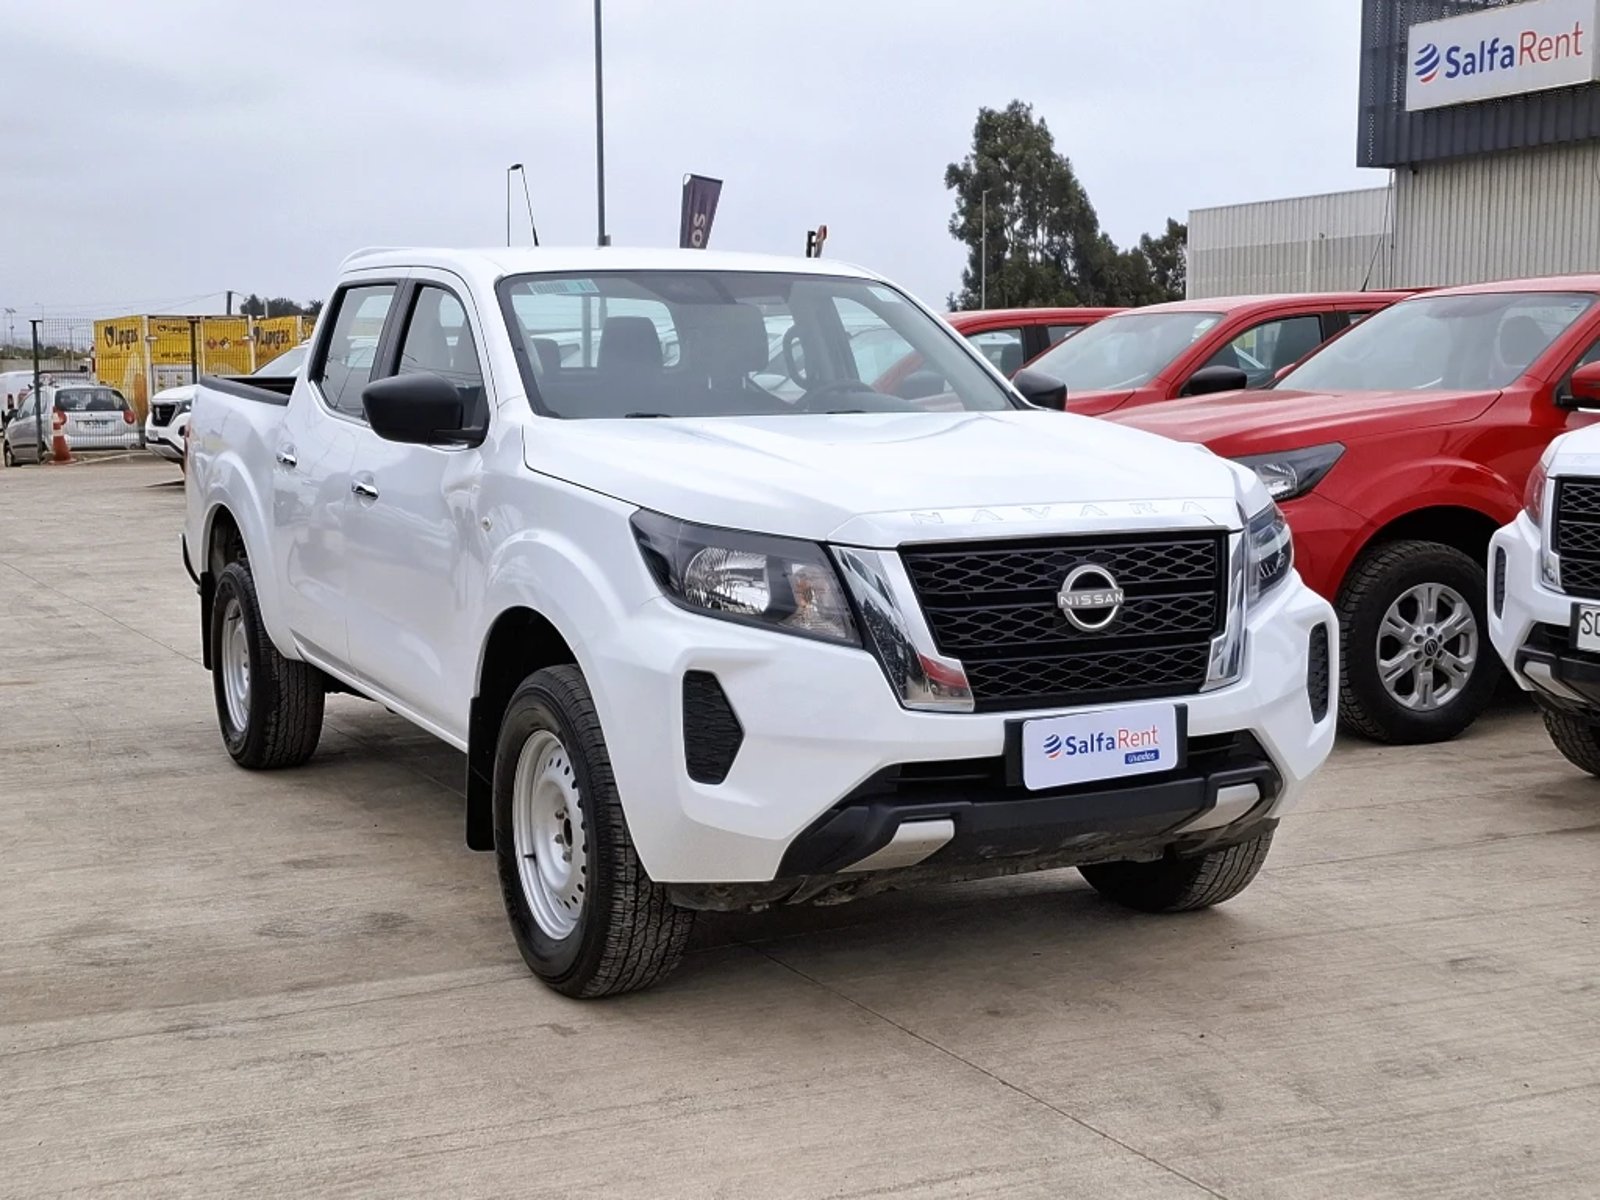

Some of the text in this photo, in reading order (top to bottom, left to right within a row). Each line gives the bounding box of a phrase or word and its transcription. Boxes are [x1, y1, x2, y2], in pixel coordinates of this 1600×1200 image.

[1445, 21, 1584, 79] SalfaRent
[910, 501, 1208, 525] NAVARA
[1060, 591, 1123, 606] NISSAN
[1066, 724, 1159, 755] SalfaRent
